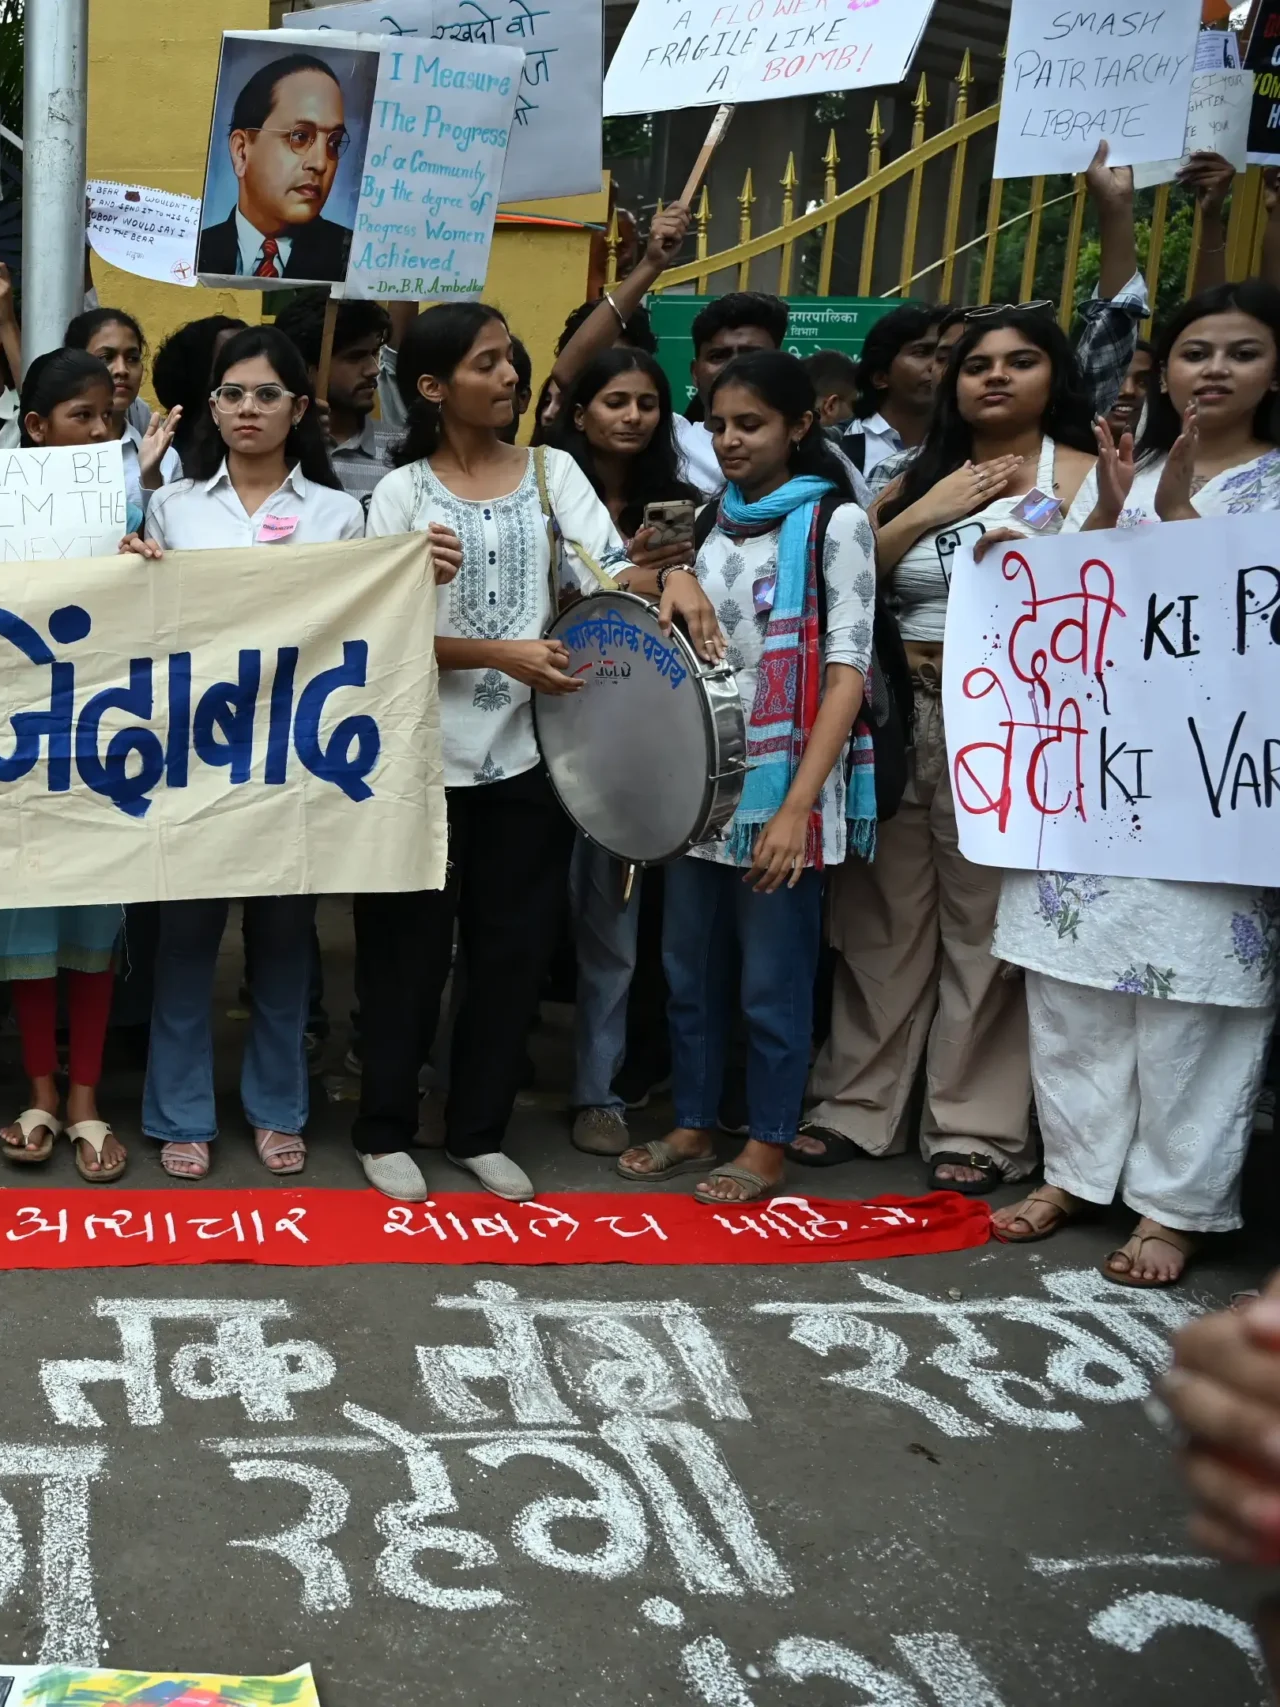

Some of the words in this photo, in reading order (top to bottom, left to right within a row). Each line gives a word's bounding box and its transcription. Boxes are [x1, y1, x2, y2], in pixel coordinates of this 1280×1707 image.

[672, 10, 692, 31] A
[1042, 10, 1166, 41] SMASH
[639, 27, 758, 73] FRAGILE
[765, 17, 848, 53] LIKE
[389, 52, 404, 81] I
[413, 54, 511, 96] Measure
[706, 65, 730, 94] A
[761, 43, 874, 82] BOMB!
[374, 100, 416, 133] The
[422, 104, 508, 152] Progress
[1020, 103, 1151, 142] LIBRATE
[86, 184, 92, 193] A
[96, 186, 120, 196] BEAR
[370, 144, 392, 168] of
[392, 157, 407, 170] a
[409, 149, 487, 199] Community
[98, 198, 115, 208] AND
[118, 203, 140, 213] SEND
[141, 207, 154, 215] IT
[360, 175, 386, 208] By
[390, 178, 414, 202] the
[421, 188, 464, 217] degree
[469, 191, 493, 217] of
[113, 228, 128, 238] THE
[130, 232, 155, 245] BEAR
[122, 217, 156, 233] WOULD
[157, 225, 176, 236] SAY
[177, 229, 186, 238] I
[425, 219, 486, 245] Women
[790, 325, 819, 337] विभाग
[72, 449, 113, 485] BE
[66, 489, 127, 526] THE
[4, 535, 104, 563] NEXT
[1001, 550, 1127, 712] देवी
[1142, 592, 1201, 661] KI
[953, 667, 1089, 834] बेटी
[1099, 726, 1154, 811] KI
[5, 1206, 311, 1246] अत्याचार
[38, 1295, 338, 1428] तक
